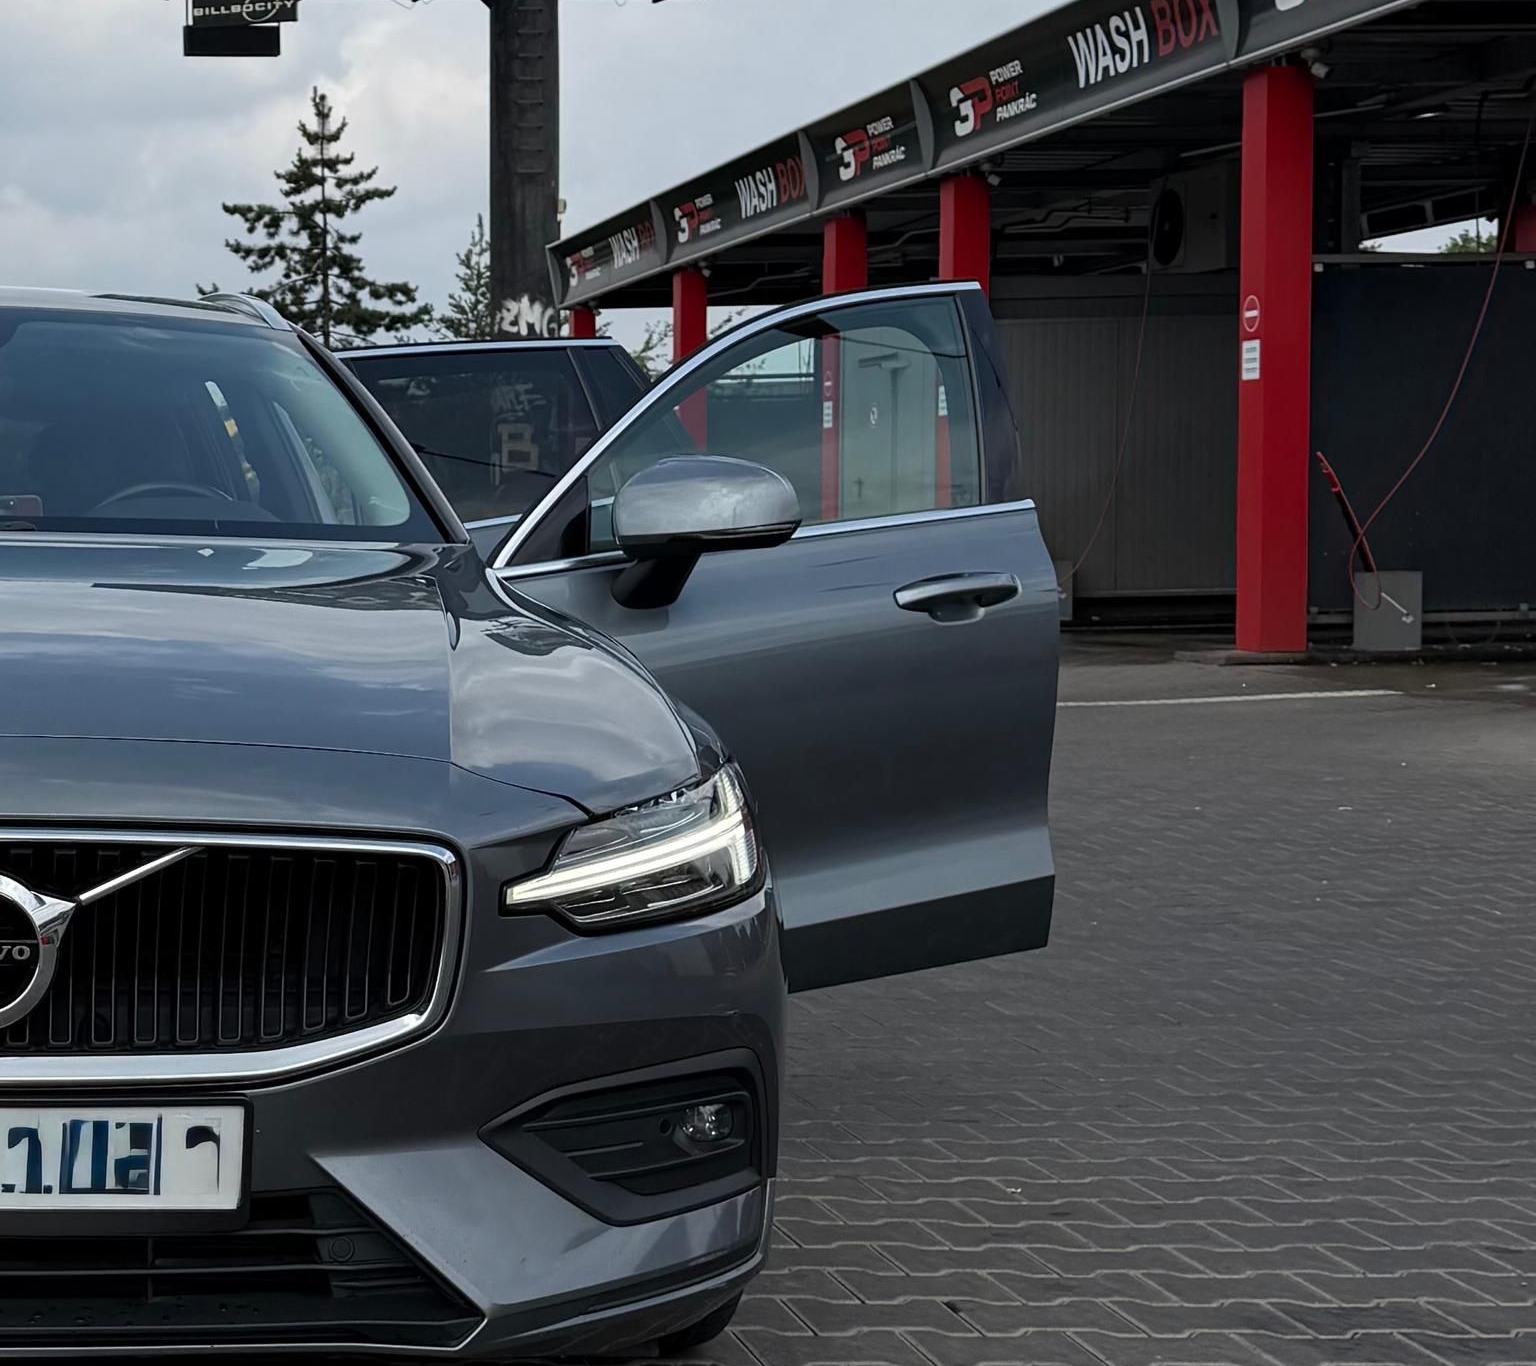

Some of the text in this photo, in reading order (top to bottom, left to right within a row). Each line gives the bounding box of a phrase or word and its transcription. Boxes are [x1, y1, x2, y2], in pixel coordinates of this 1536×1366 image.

[1067, 5, 1151, 89] WASH
[988, 59, 1024, 86] POWER
[995, 92, 1037, 123] PANKRÁC
[733, 165, 778, 220] WASH
[608, 226, 640, 270] WASH
